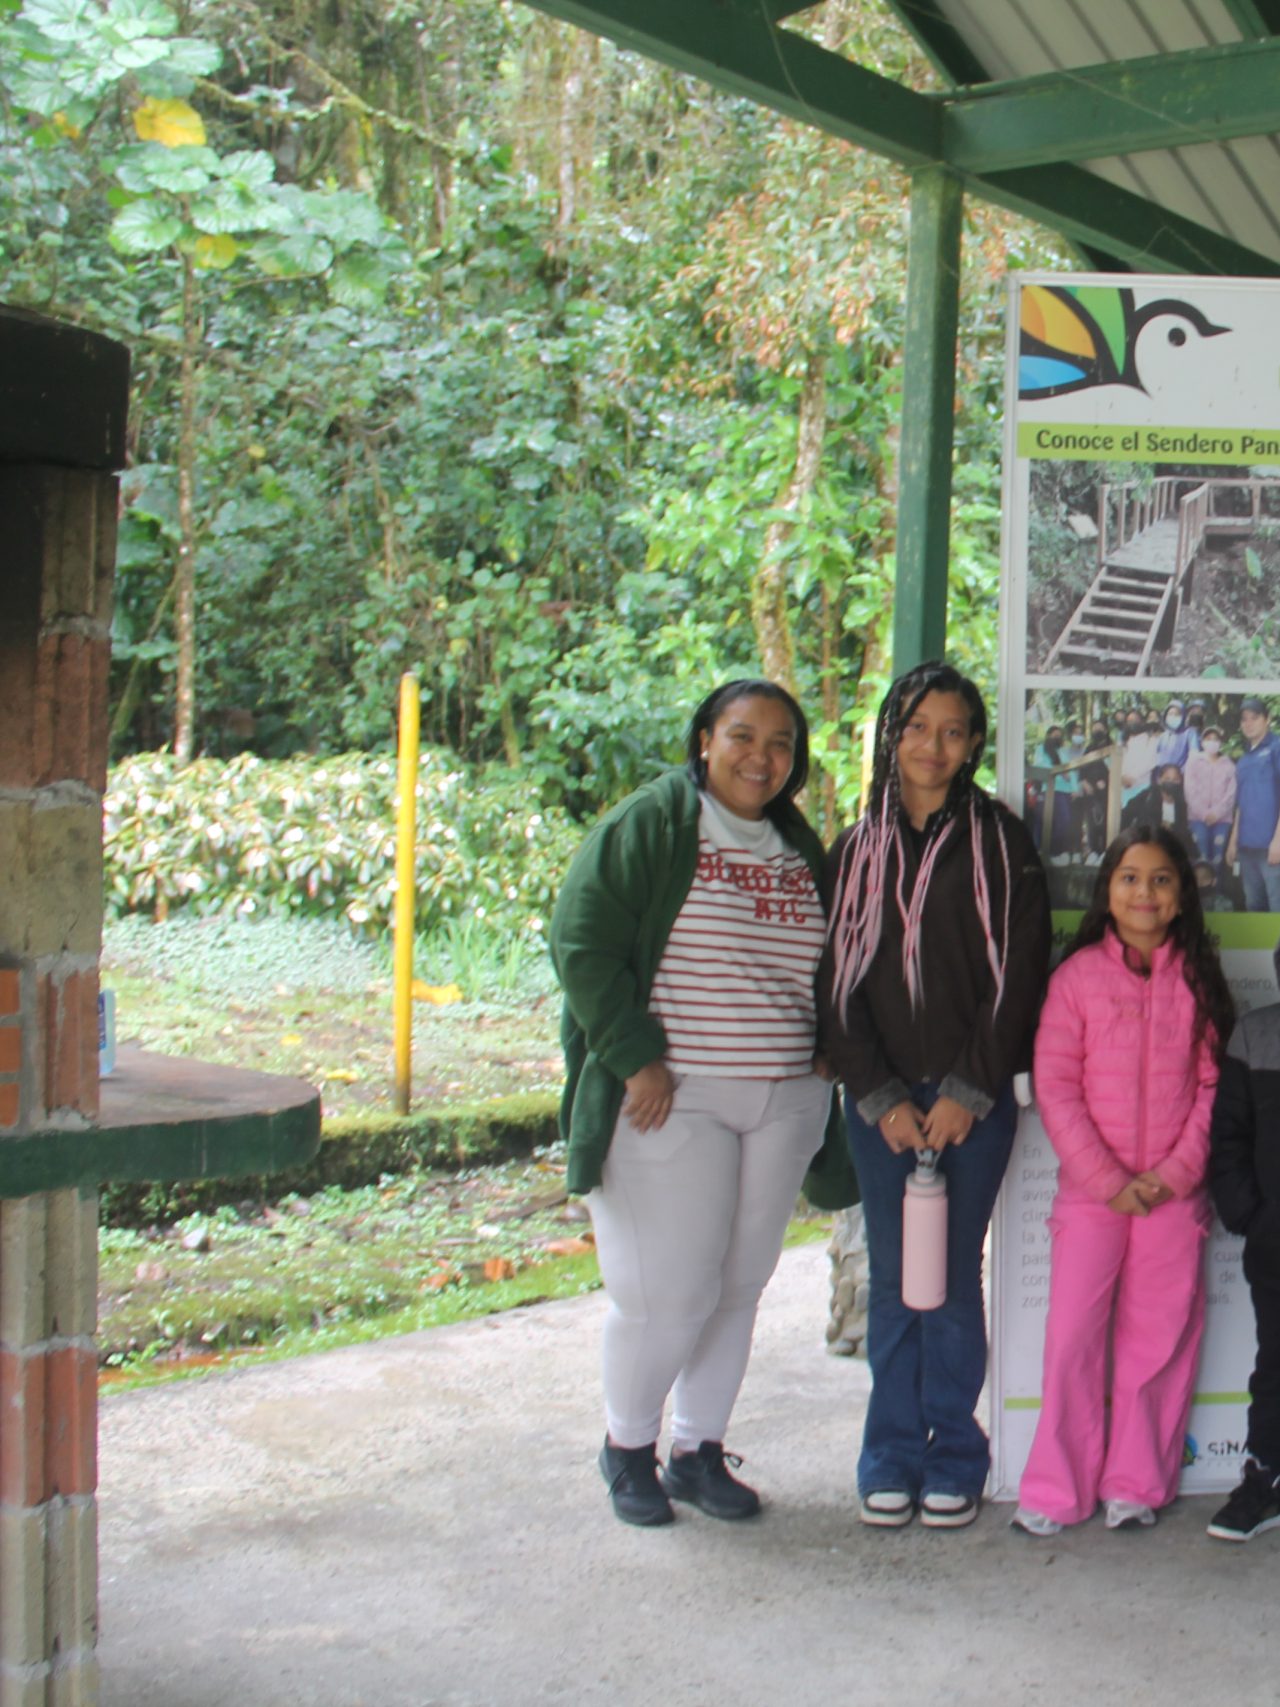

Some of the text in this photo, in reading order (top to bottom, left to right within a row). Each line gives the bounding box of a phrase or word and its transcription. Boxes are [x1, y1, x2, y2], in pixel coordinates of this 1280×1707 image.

[1036, 429, 1114, 450] Conoce
[1121, 431, 1139, 451] el
[1147, 432, 1233, 454] Sendero
